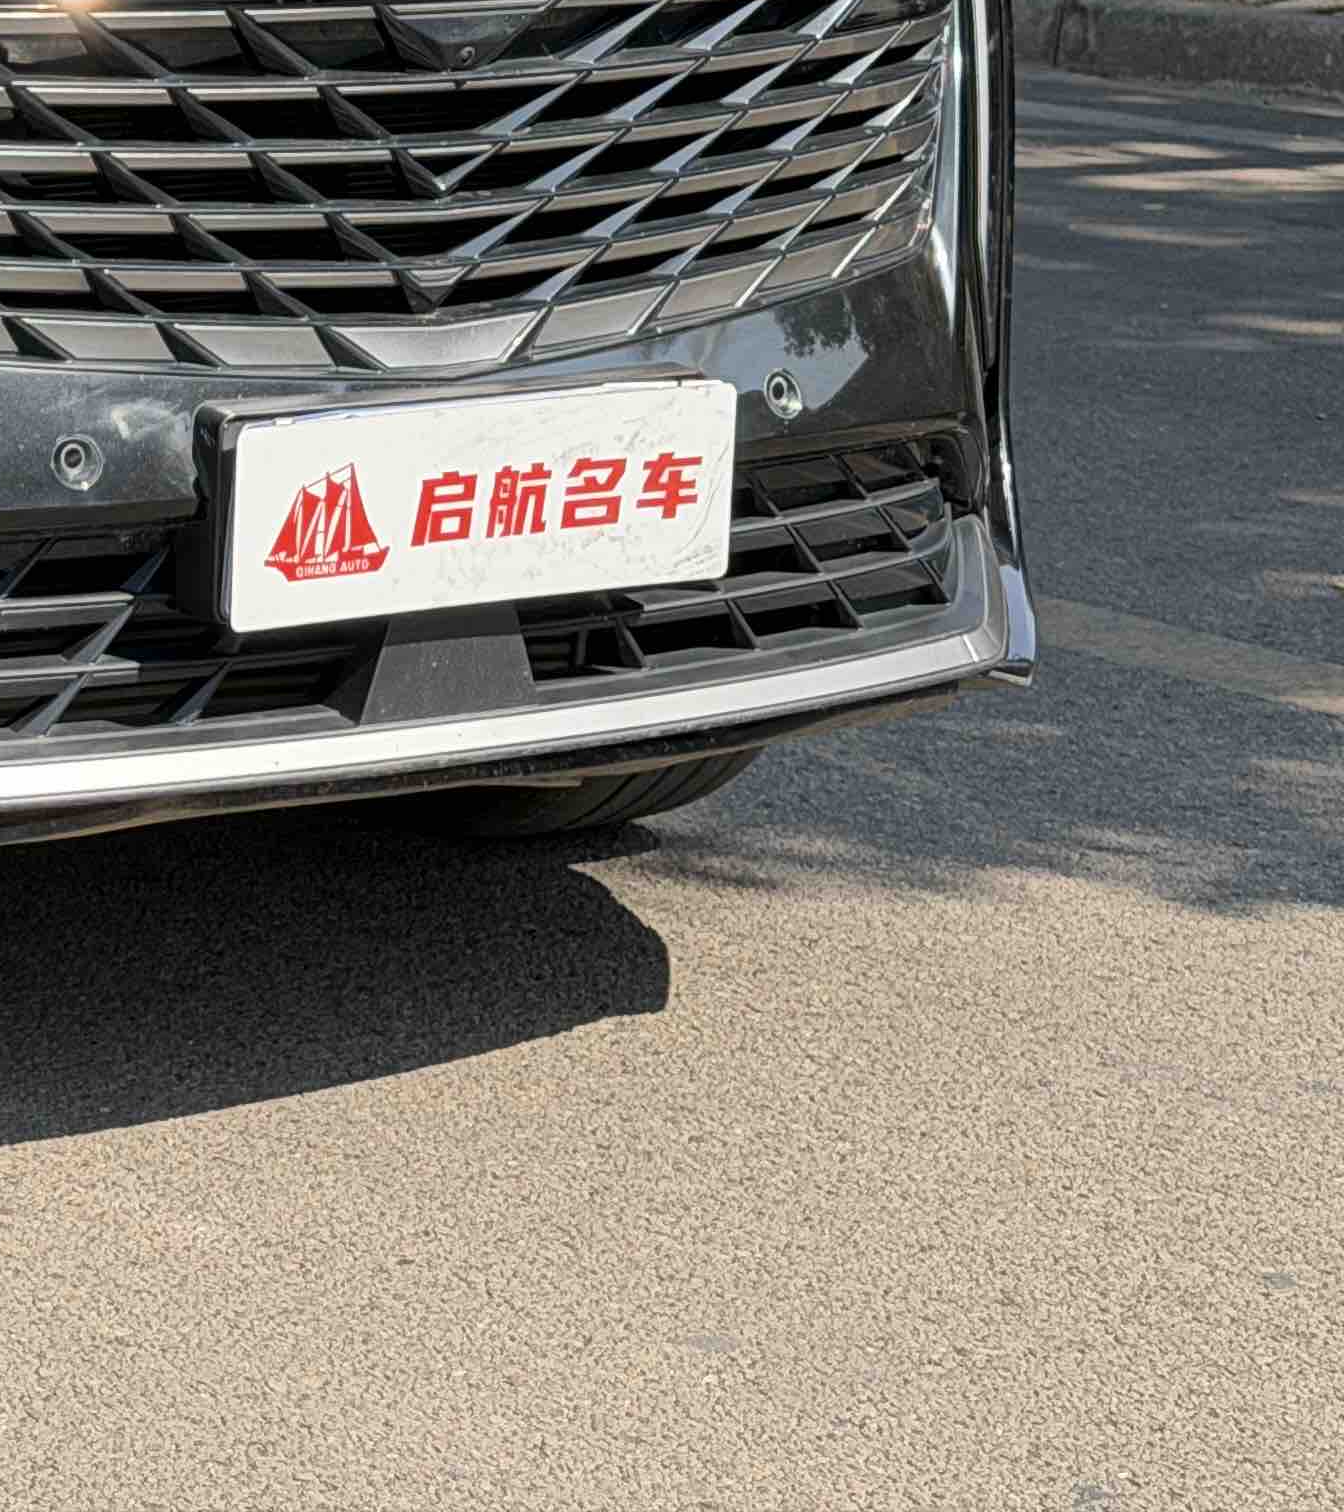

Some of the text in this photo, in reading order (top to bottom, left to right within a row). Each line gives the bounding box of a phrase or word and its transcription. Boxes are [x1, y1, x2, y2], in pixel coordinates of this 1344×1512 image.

[411, 452, 703, 547] 启航名车
[295, 557, 370, 578] QIHANG AUTO
